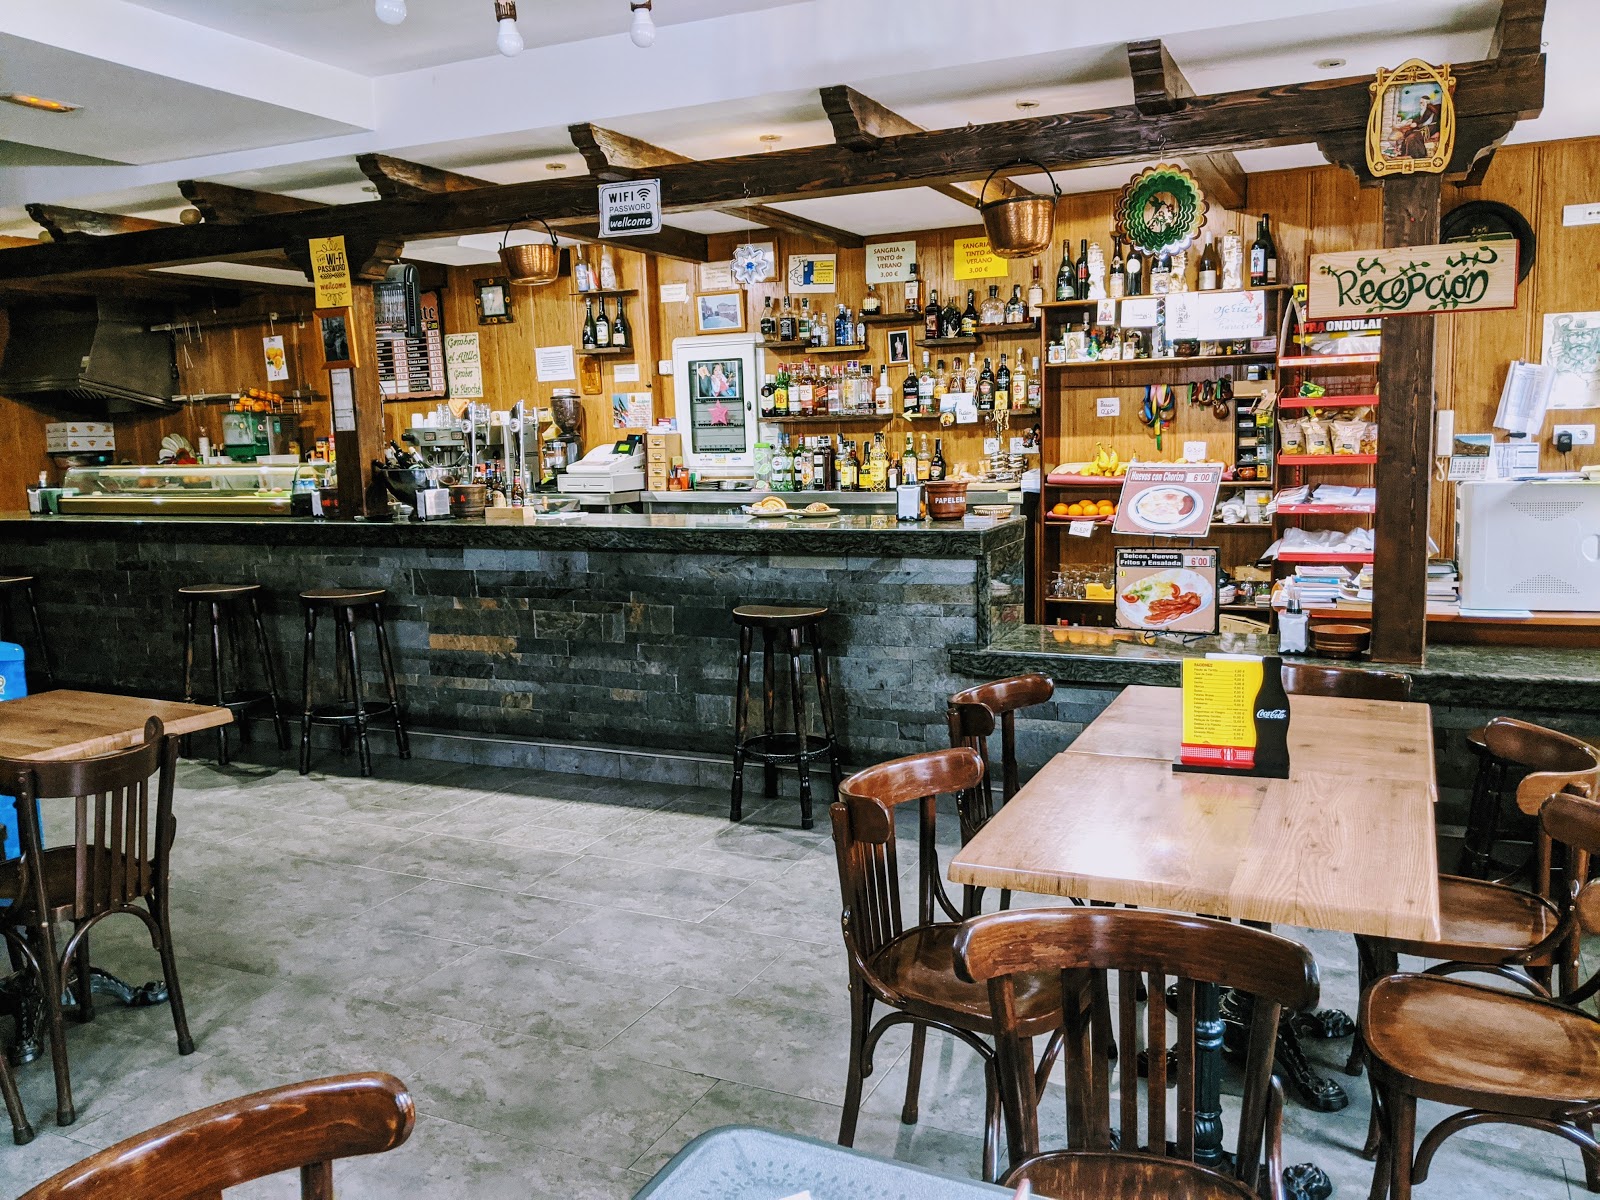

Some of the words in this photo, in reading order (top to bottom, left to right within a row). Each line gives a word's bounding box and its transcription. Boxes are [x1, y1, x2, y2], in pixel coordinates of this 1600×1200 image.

[608, 191, 634, 204] WIFI
[609, 203, 652, 213] PASSWORD
[610, 216, 651, 228] wellcome
[325, 252, 345, 265] WI-FI
[317, 264, 346, 273] PASSWORD
[1337, 267, 1489, 309] Recepción
[1131, 471, 1151, 481] Huevos
[1151, 473, 1162, 481] con
[1163, 471, 1185, 482] Chorizo
[1256, 708, 1287, 719] Coca-Cola
